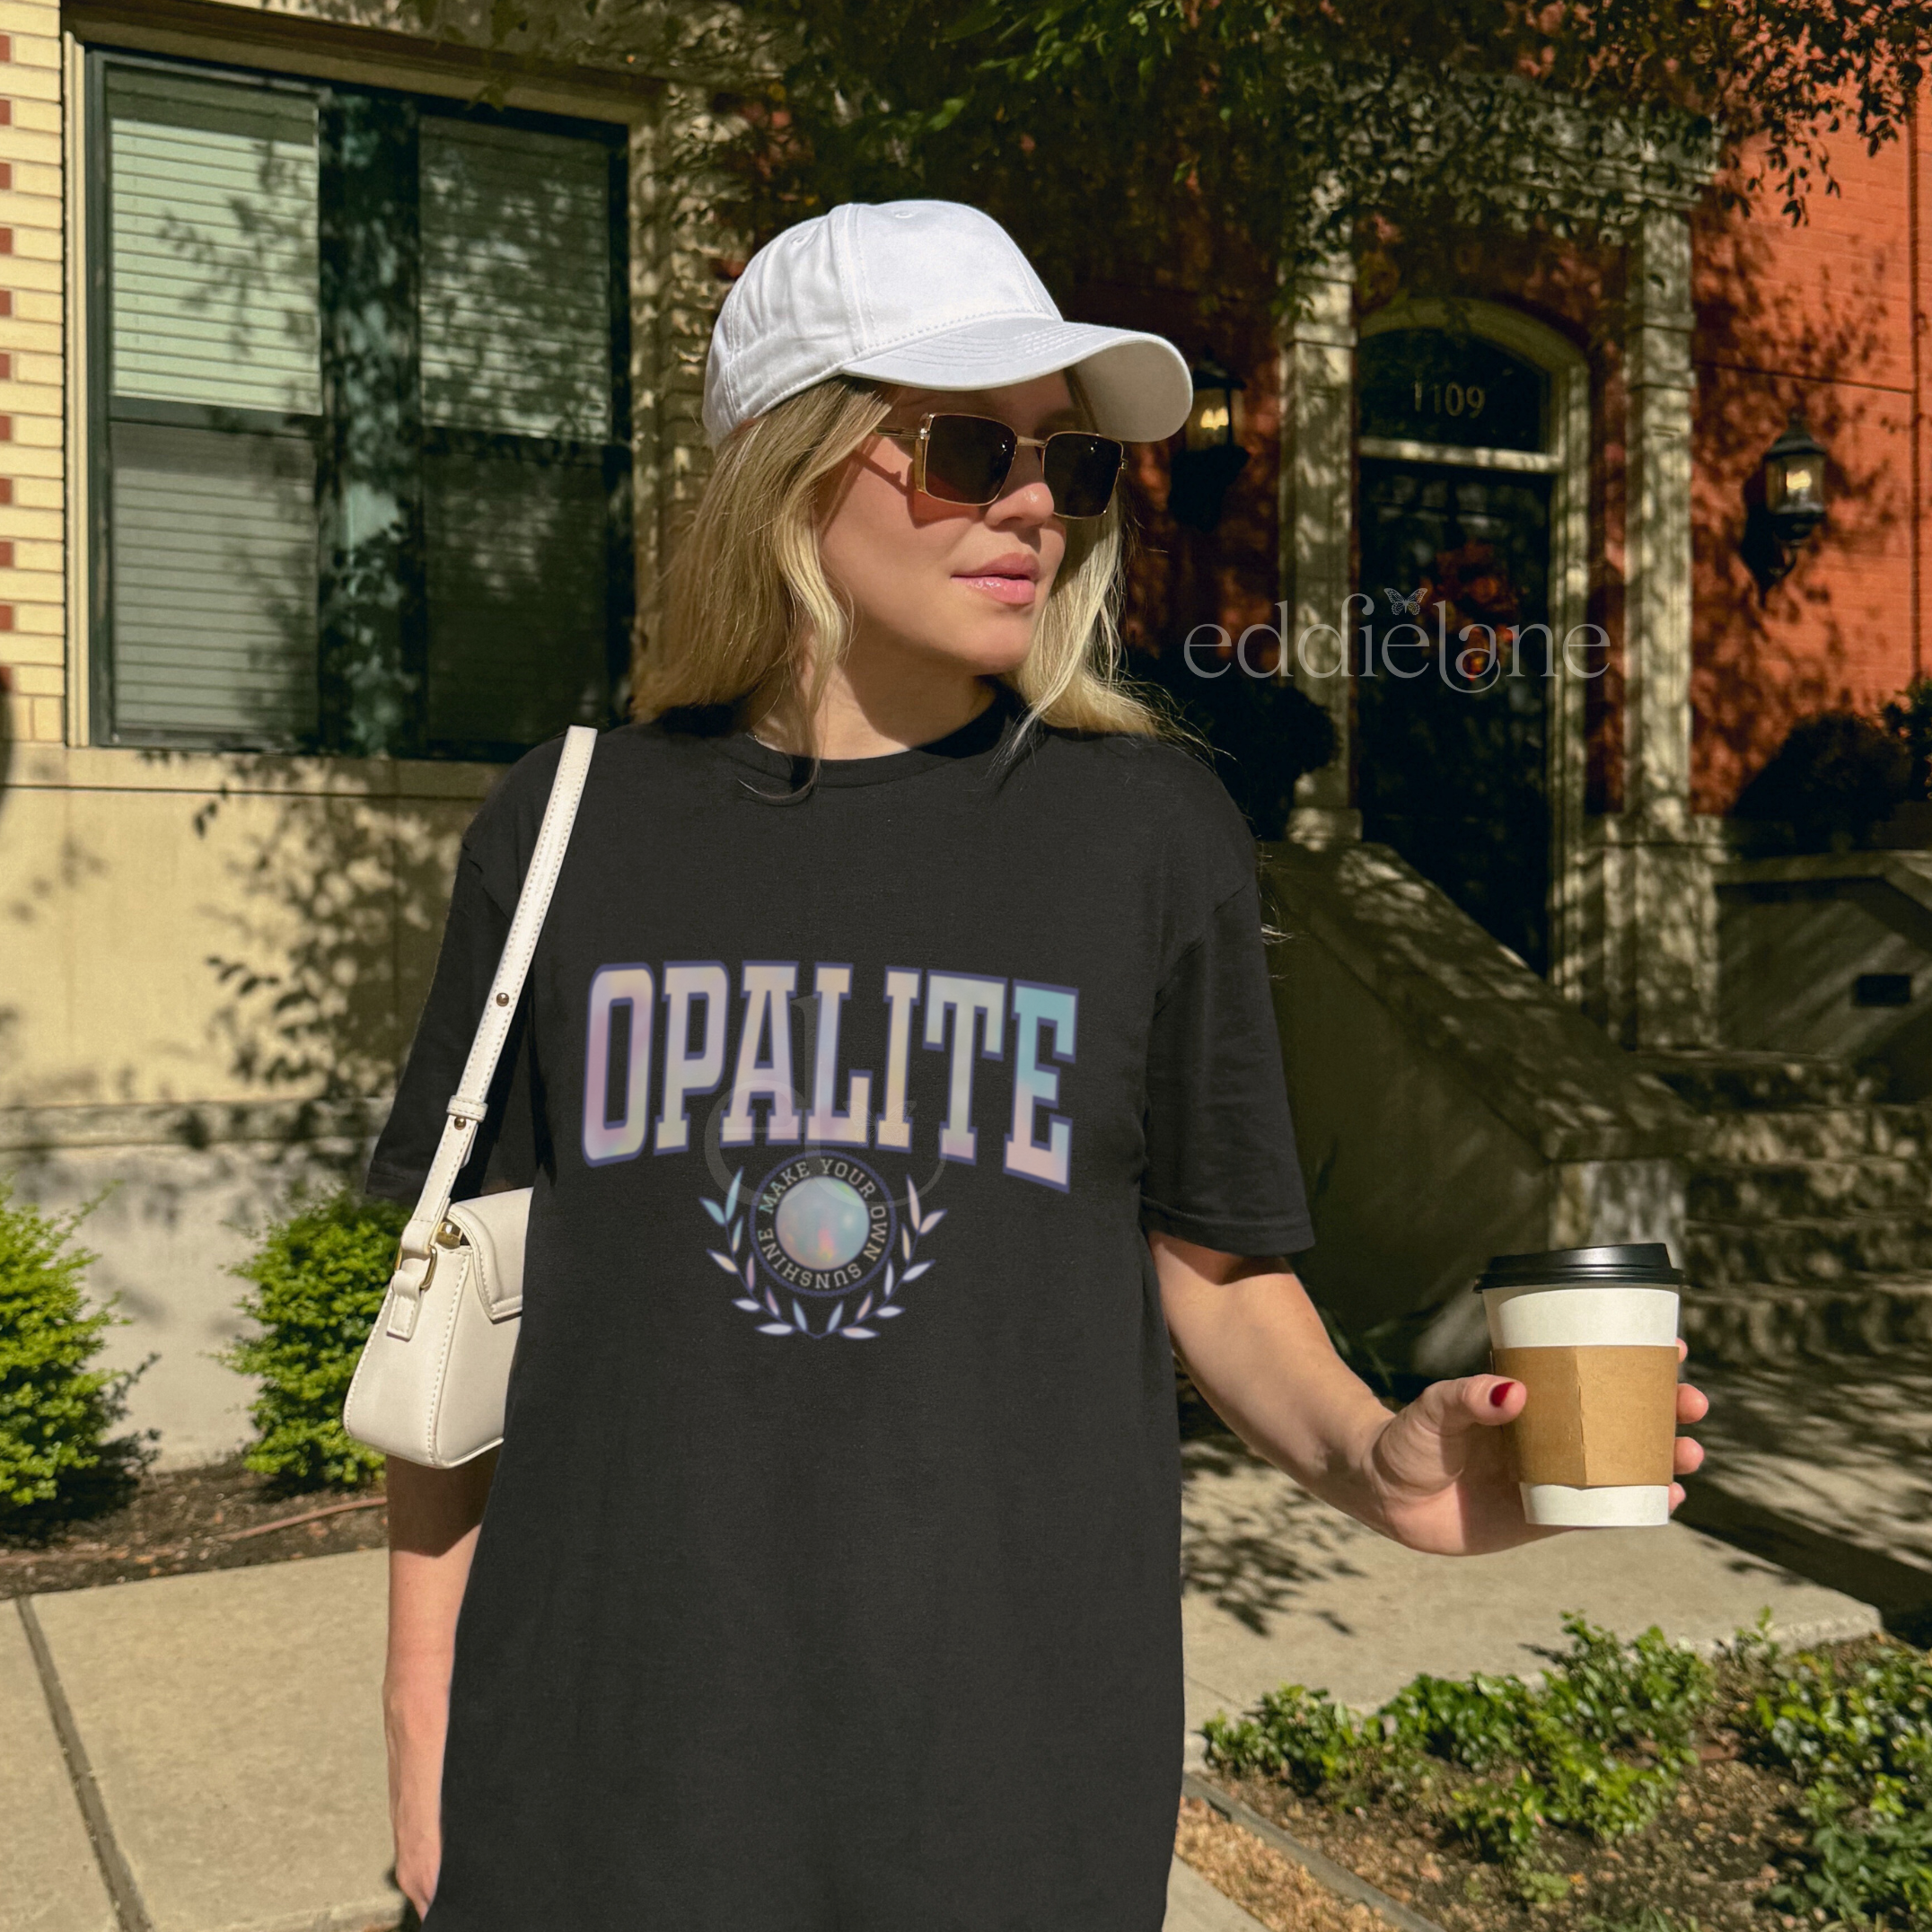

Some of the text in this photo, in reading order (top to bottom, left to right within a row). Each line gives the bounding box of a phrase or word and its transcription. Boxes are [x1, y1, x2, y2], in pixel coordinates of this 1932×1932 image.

[1412, 381, 1486, 418] 1109
[582, 960, 1078, 1194] OPALITE
[758, 1158, 888, 1289] MAKE YOUR OWN SUNSHINE
